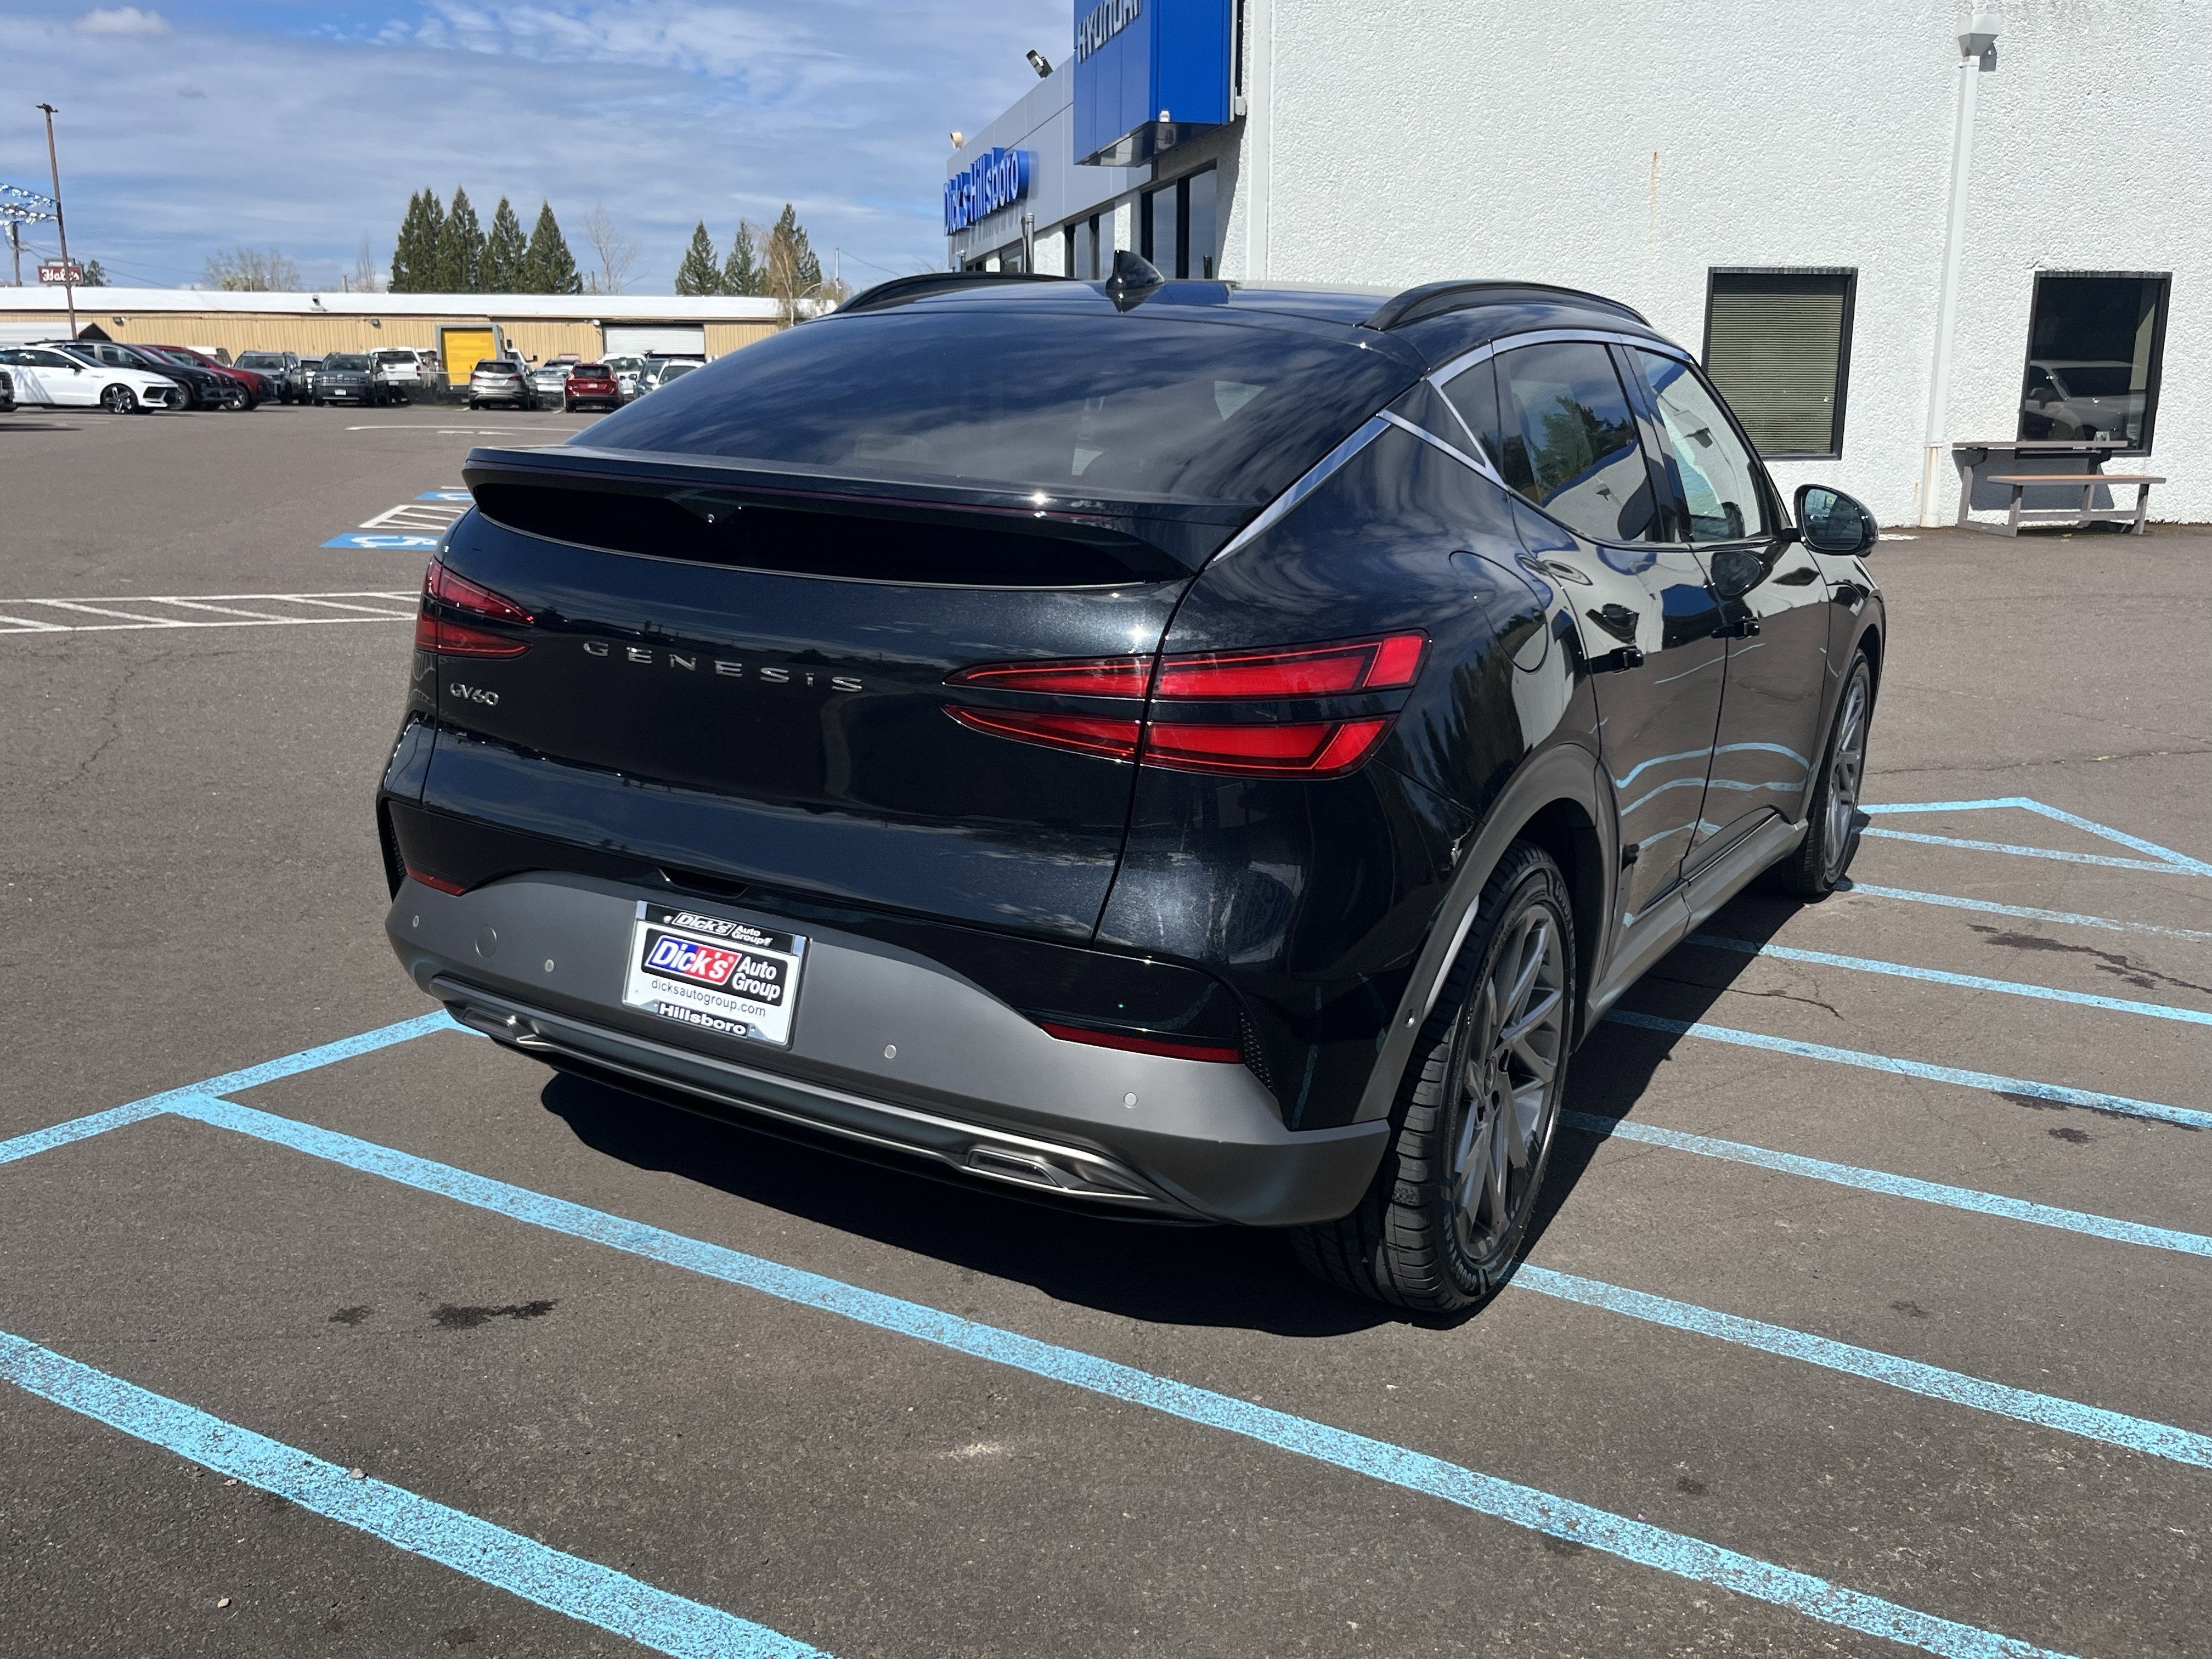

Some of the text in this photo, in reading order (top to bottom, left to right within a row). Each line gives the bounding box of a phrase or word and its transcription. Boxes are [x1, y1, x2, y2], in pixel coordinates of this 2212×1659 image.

[970, 148, 1022, 222] Hillsboro
[583, 640, 862, 693] GENESIS
[450, 682, 499, 707] GV60
[676, 914, 732, 934] Dick's
[731, 930, 765, 946] Group
[737, 926, 761, 936] Auto
[651, 940, 729, 979] Dick's
[737, 956, 777, 980] Auto
[651, 978, 766, 1017] dicksautogroup.com
[731, 972, 781, 1001] Group
[659, 1002, 747, 1035] Hillsboro
